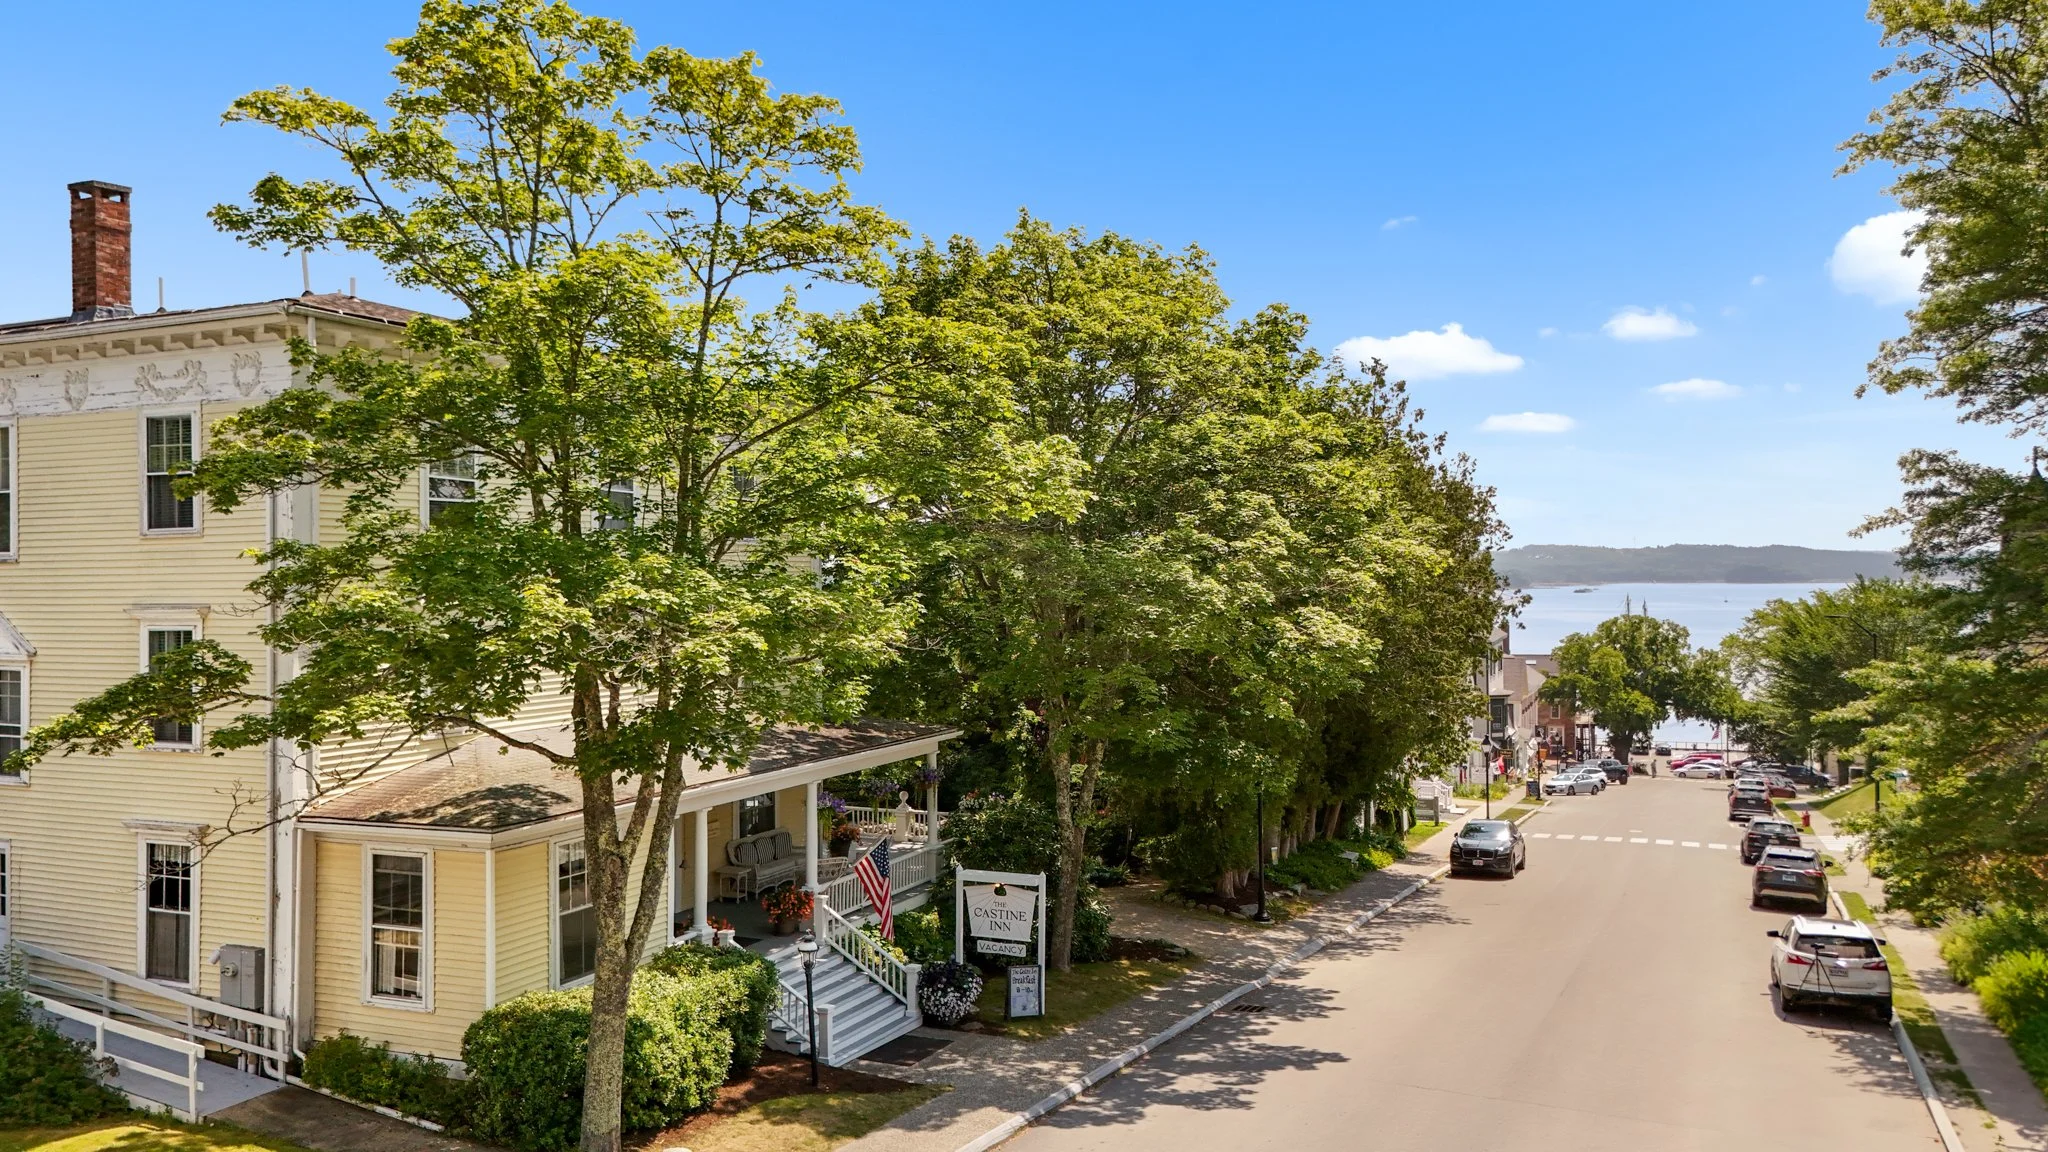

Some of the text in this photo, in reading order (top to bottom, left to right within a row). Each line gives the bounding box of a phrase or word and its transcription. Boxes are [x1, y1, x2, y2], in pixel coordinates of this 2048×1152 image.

[974, 908, 1027, 922] CASTINE
[990, 920, 1011, 932] INN
[979, 943, 1024, 955] VACANCY
[1012, 975, 1036, 984] Breakfast
